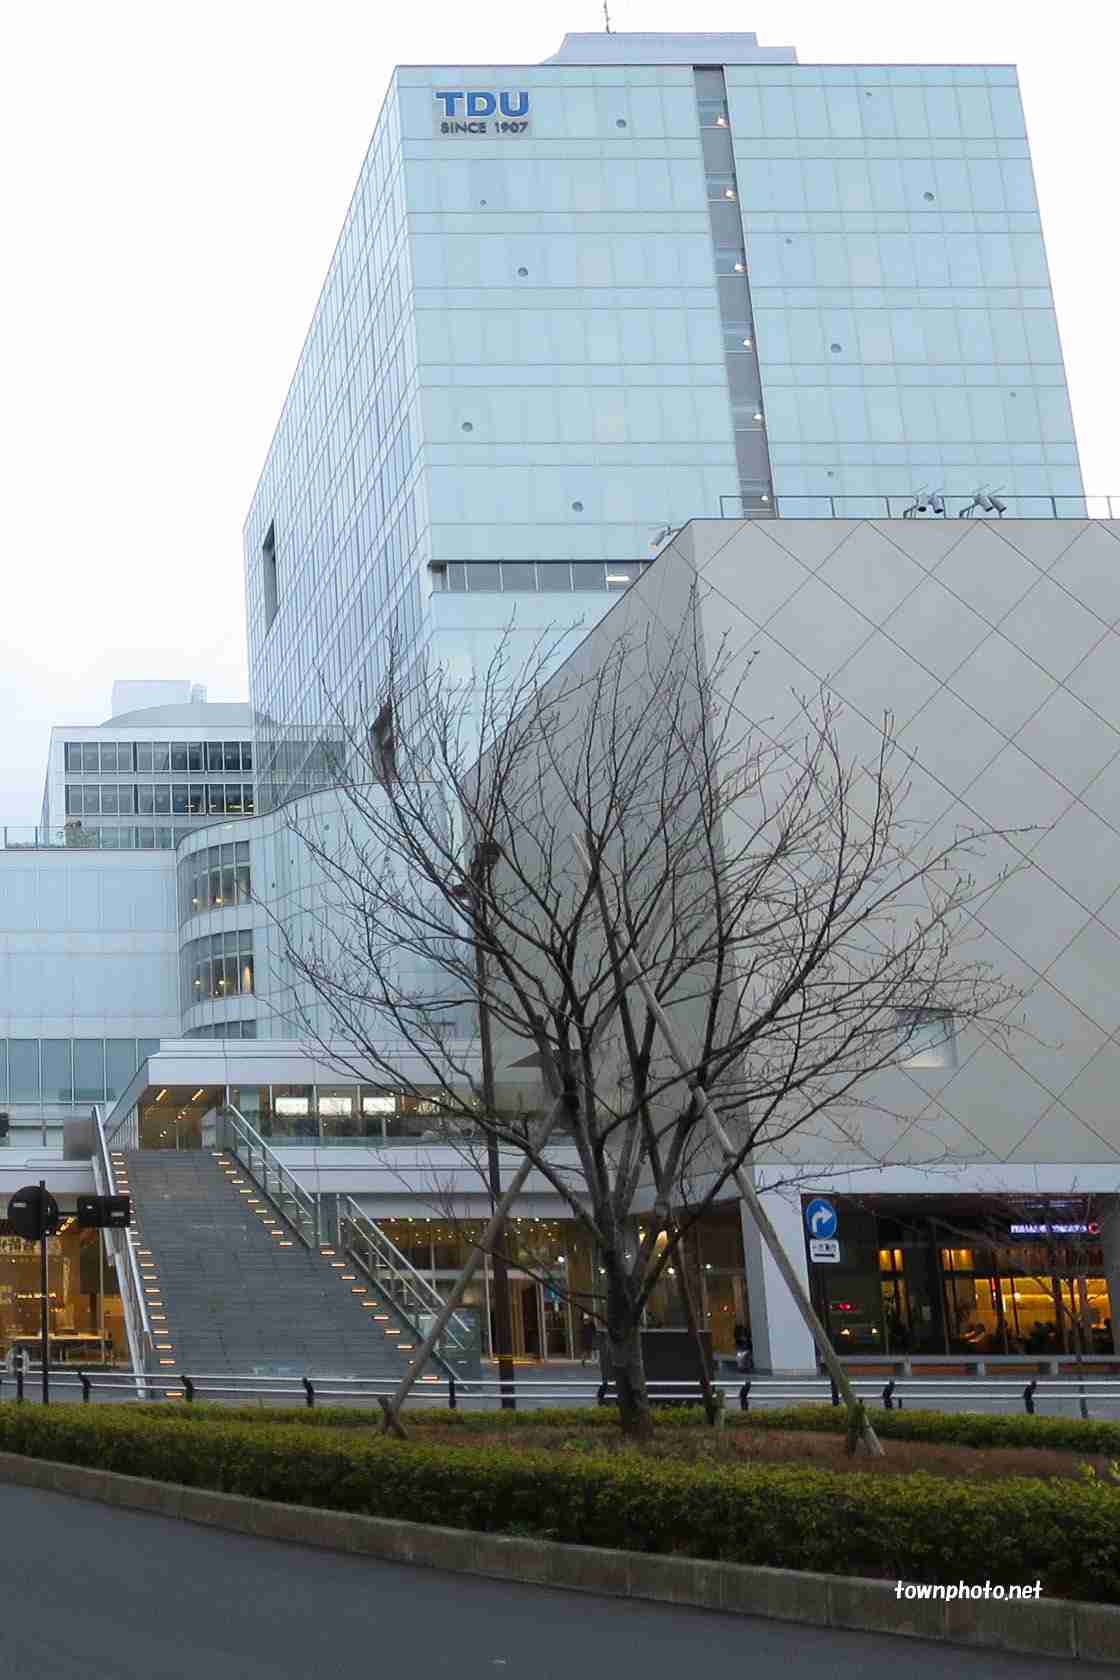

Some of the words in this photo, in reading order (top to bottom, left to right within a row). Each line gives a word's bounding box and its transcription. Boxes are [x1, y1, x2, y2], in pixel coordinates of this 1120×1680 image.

[436, 92, 528, 117] TDU
[440, 122, 487, 134] SINCE
[495, 122, 528, 134] 1907
